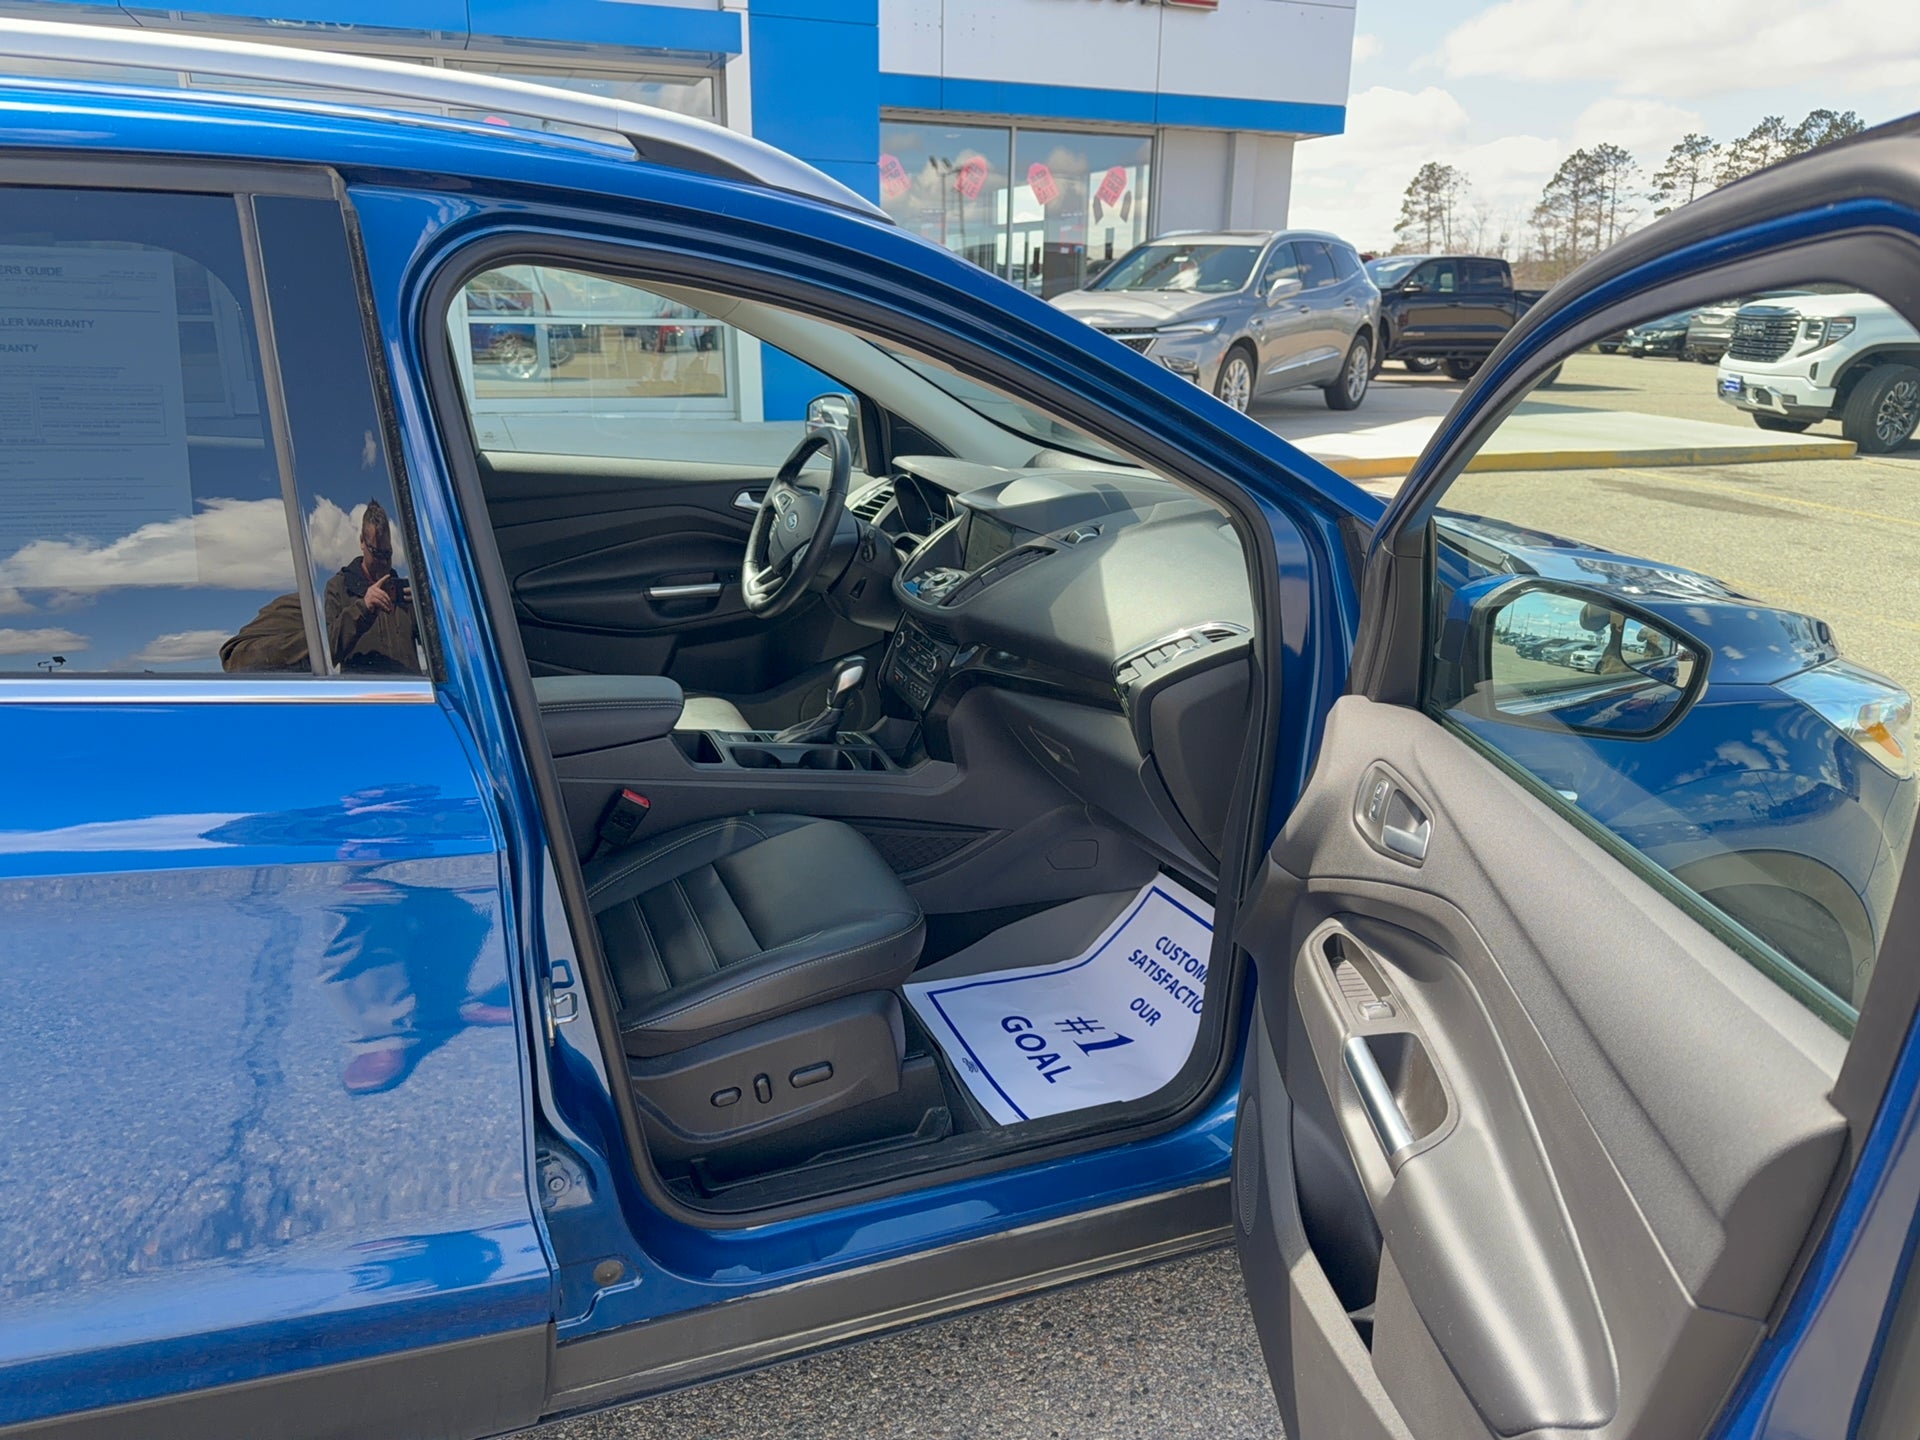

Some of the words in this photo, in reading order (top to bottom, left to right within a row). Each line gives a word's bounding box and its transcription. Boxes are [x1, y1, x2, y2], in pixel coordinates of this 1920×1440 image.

[25, 266, 64, 276] GUIDE
[26, 318, 95, 329] WARRANTY
[1155, 936, 1208, 985] CUSTOM
[1128, 949, 1204, 1014] SATISFACTIO
[1129, 997, 1162, 1027] OUR
[1001, 1016, 1072, 1084] GOAL
[1054, 1016, 1135, 1057] #1
